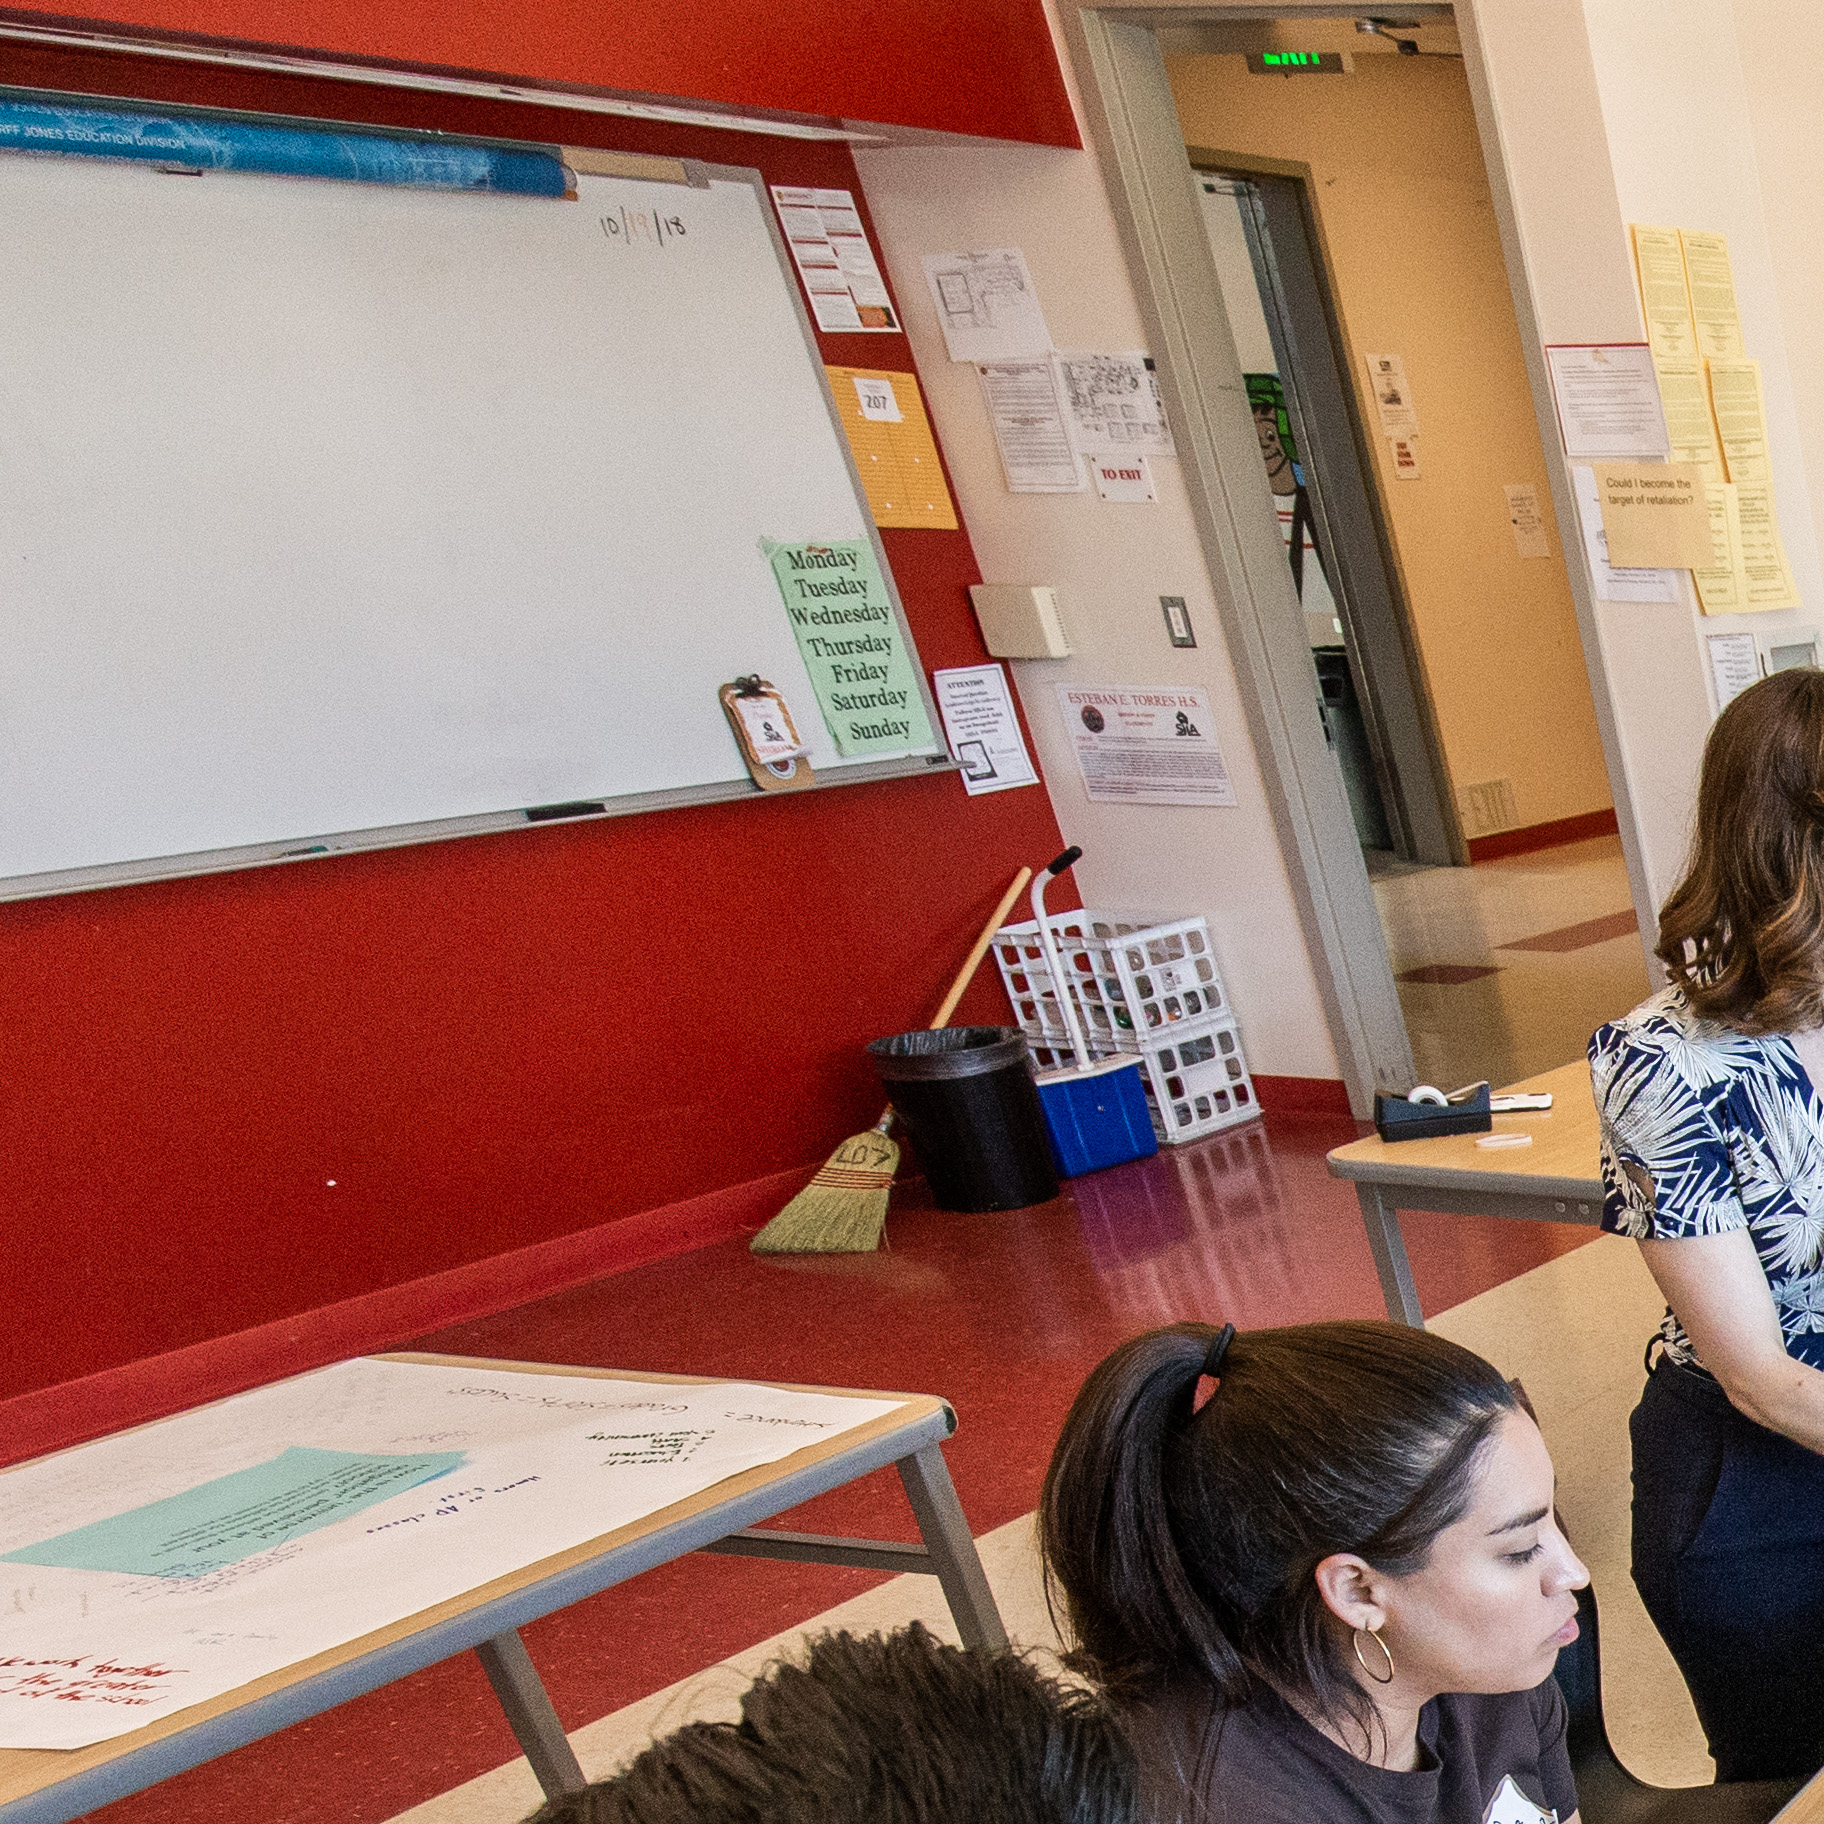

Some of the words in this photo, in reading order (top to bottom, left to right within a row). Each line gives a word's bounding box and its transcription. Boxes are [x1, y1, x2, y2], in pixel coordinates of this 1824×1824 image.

[24, 126, 63, 140] JONES
[66, 129, 134, 144] EDUCATION
[135, 133, 186, 149] DIVISION
[1101, 468, 1117, 480] TO
[1119, 469, 1142, 481] EXIT
[1606, 477, 1632, 488] Could
[1640, 480, 1675, 489] become
[1608, 495, 1634, 506] target
[787, 549, 857, 571] Monday
[794, 576, 867, 598] Tuesday
[790, 602, 889, 625] Wednesday
[807, 634, 891, 656] Thursday
[831, 662, 888, 683] Friday
[831, 688, 907, 711] Saturday
[1068, 692, 1118, 705] ESTEBAN
[1131, 693, 1176, 707] TORRES
[850, 719, 910, 739] Sunday
